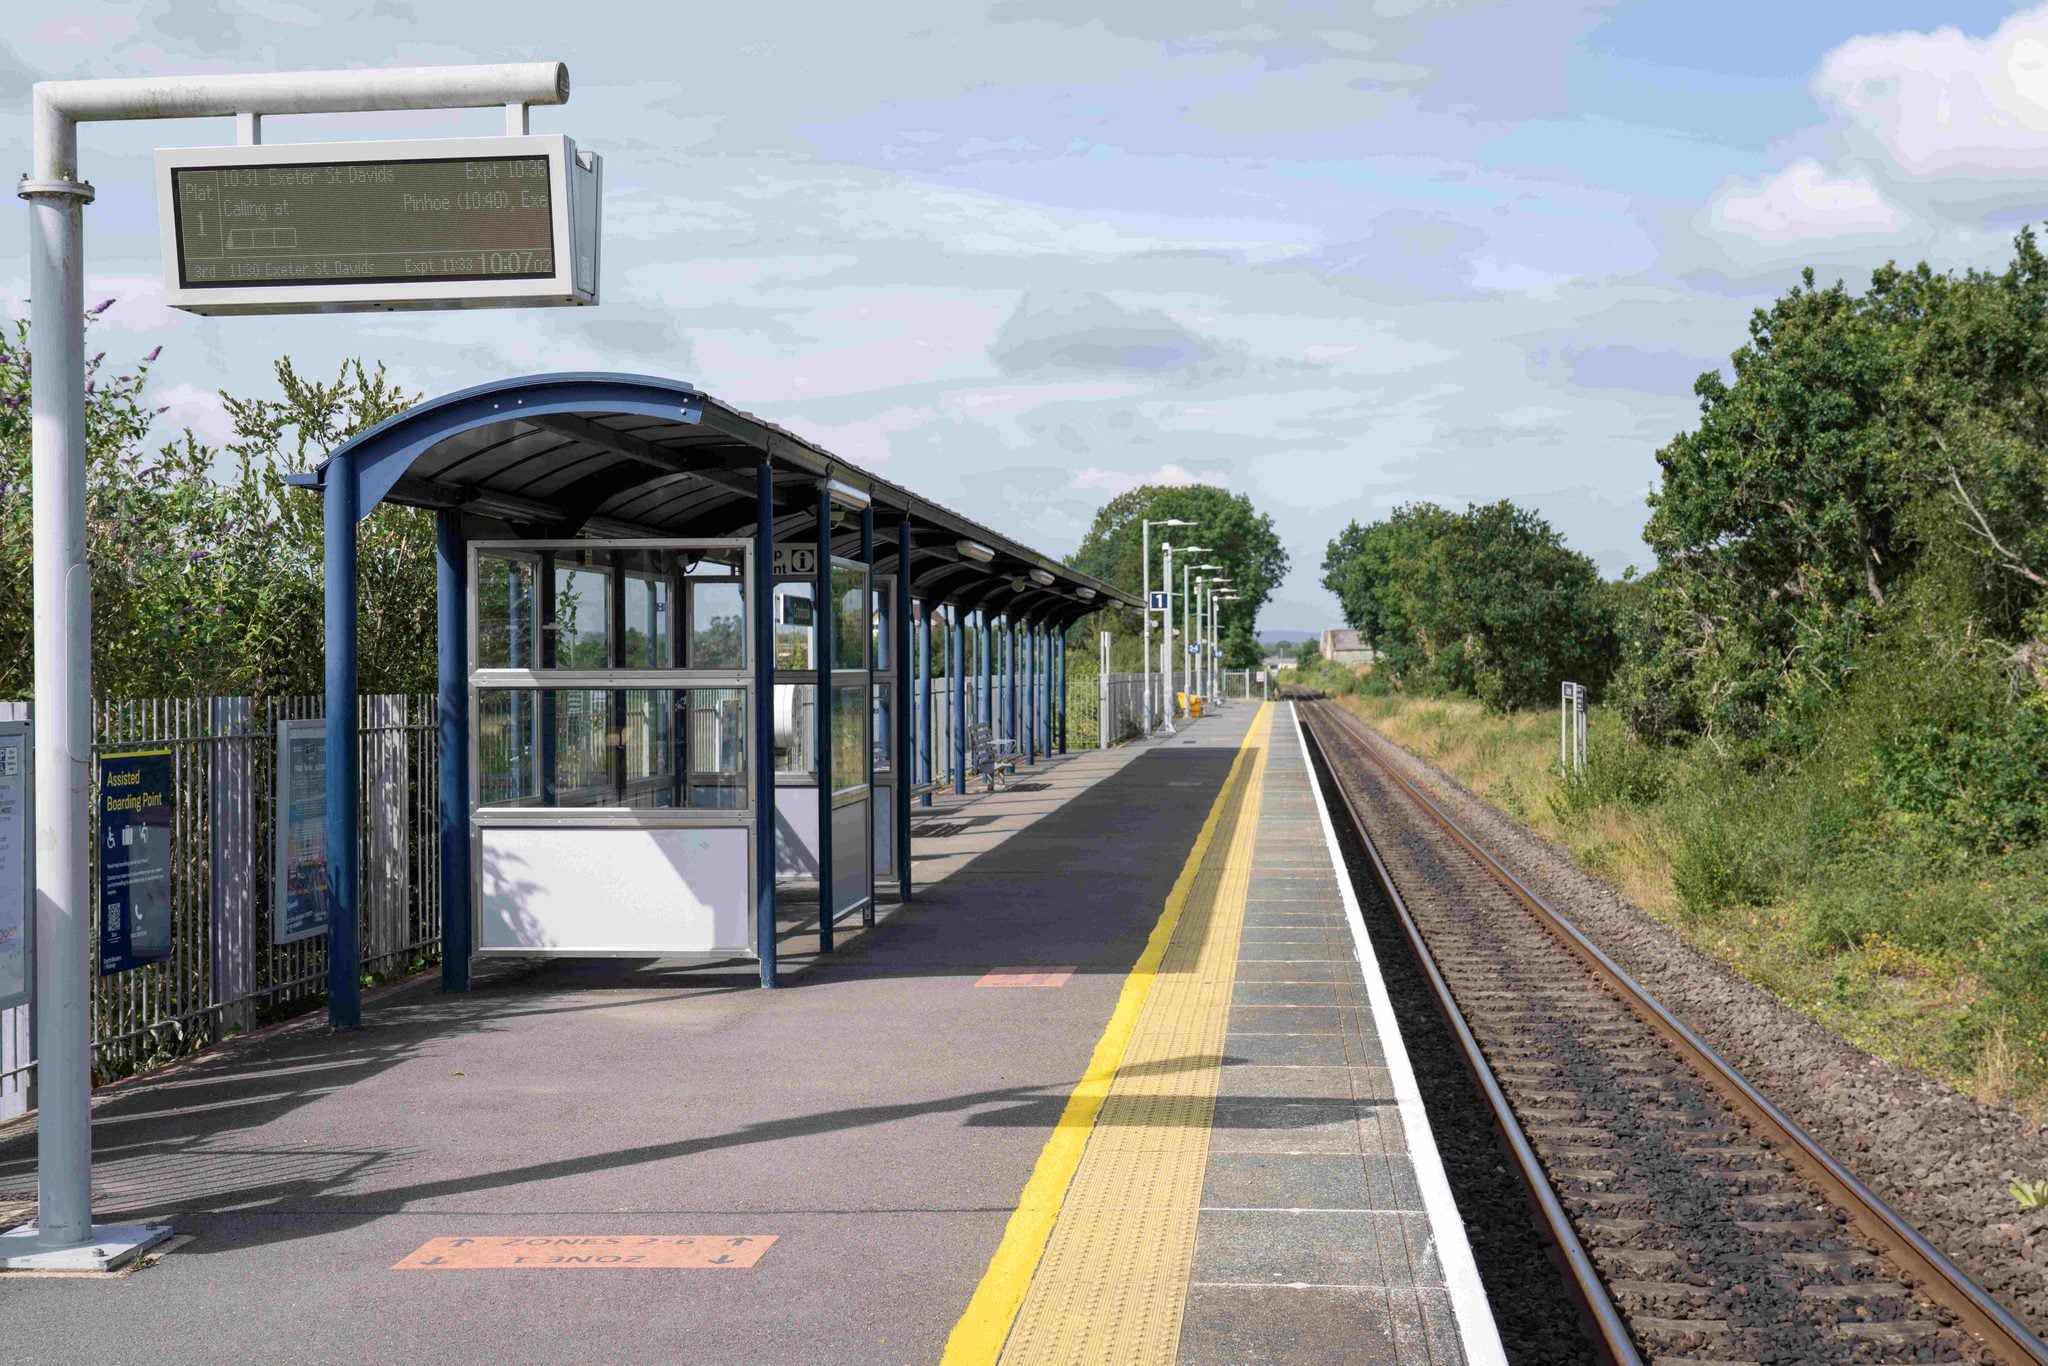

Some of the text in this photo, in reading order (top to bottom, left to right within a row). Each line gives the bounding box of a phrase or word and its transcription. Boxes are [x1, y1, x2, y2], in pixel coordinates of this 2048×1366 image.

[222, 165, 395, 187] 10:31 Exeter St Davids
[465, 159, 547, 184] Expt 10:36
[185, 182, 213, 201] Plat
[403, 192, 450, 212] Pinhoe
[520, 190, 548, 208] Exe
[223, 198, 267, 221] Calling
[196, 211, 207, 236] 1
[193, 260, 376, 279] 3rd 11:30 Exeter St Davids
[404, 258, 435, 276] Expt
[1155, 594, 1163, 608] 1
[107, 769, 140, 787] Assisted
[107, 791, 163, 812] Boarding Point
[502, 1237, 622, 1246] ZONES
[514, 1255, 647, 1264] ZONE 1
